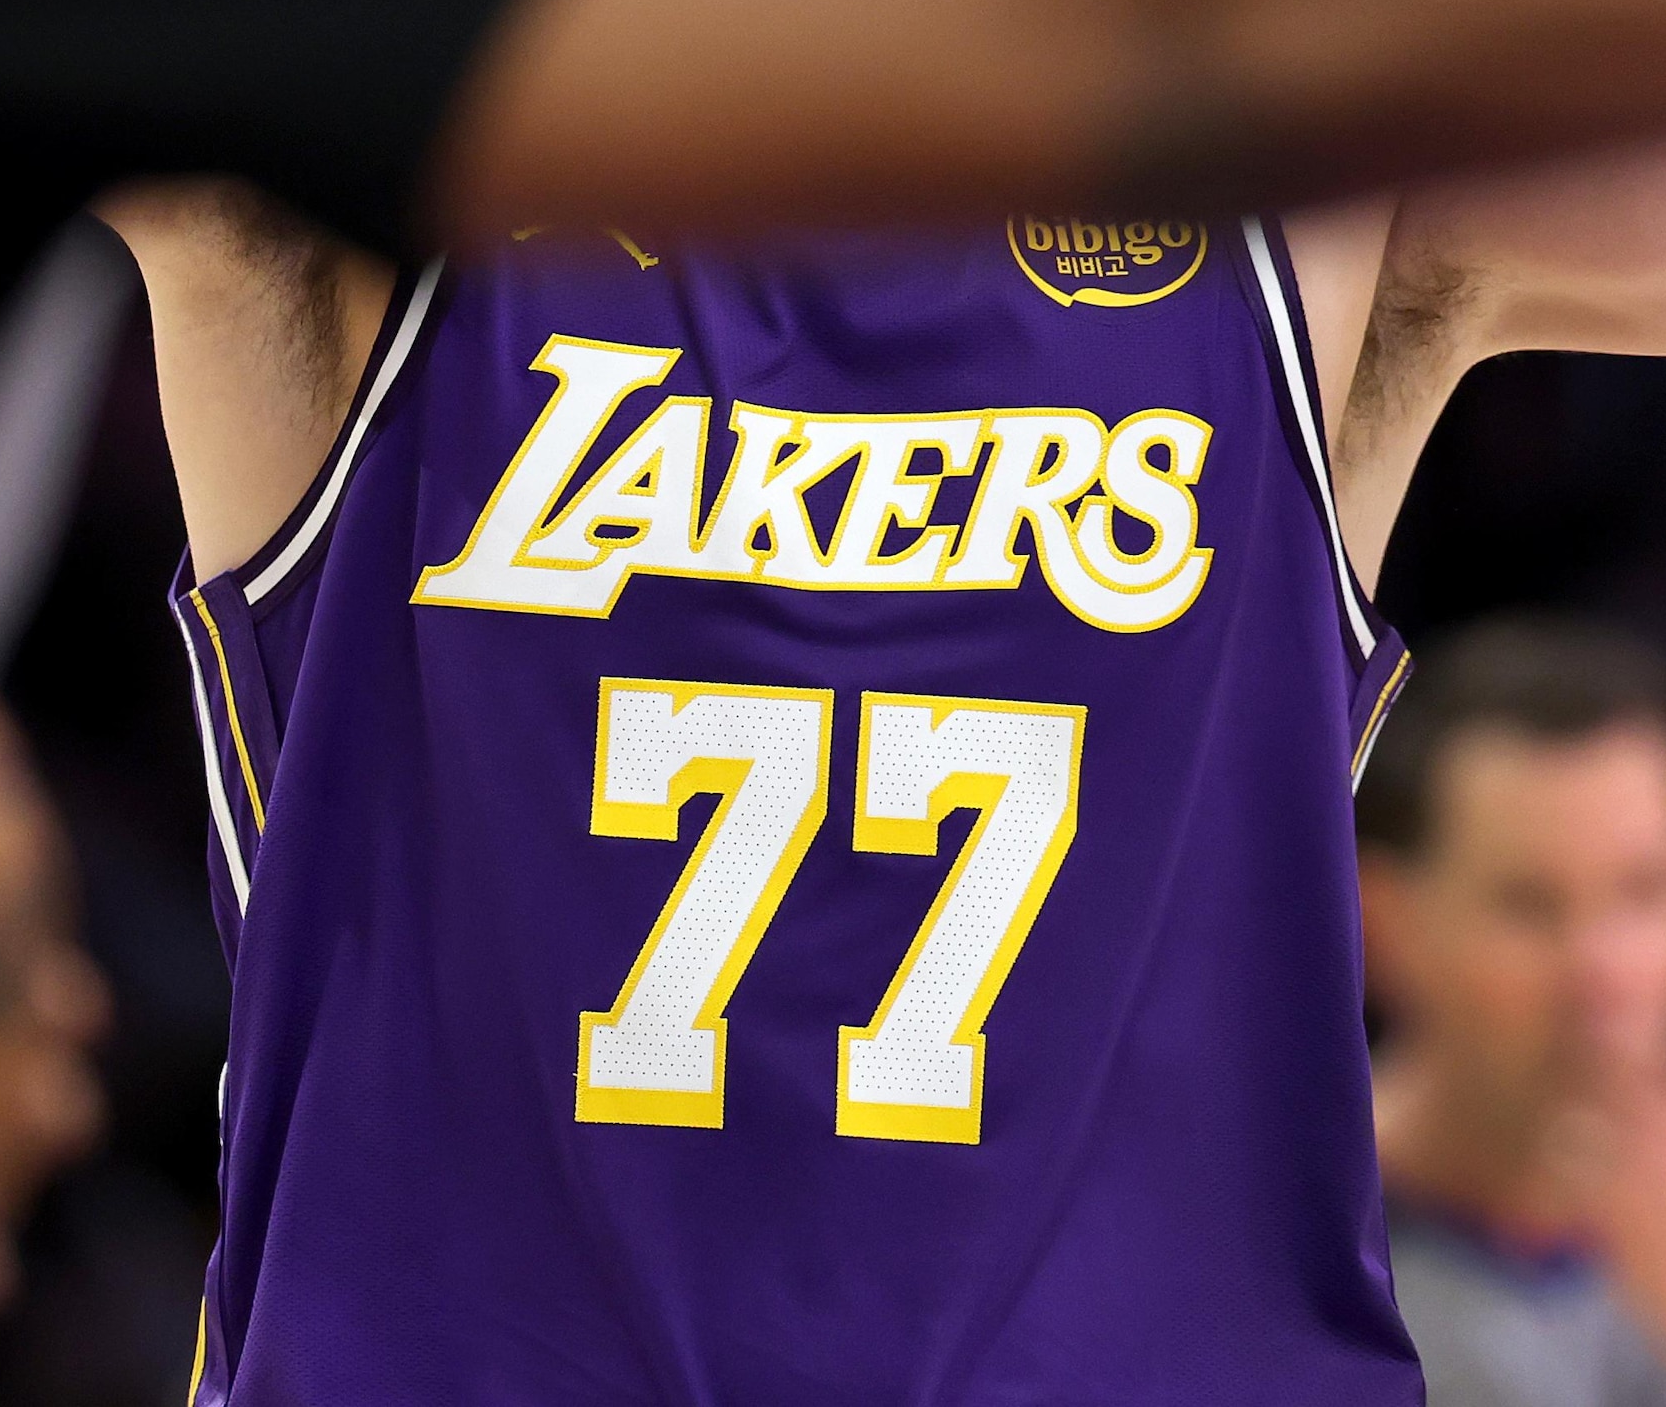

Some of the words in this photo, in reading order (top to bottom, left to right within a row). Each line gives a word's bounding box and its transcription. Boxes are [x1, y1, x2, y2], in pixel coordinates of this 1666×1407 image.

[1024, 211, 1194, 266] bibigo
[1055, 255, 1129, 278] 비비고
[409, 333, 1215, 634] LAKERS
[574, 676, 1089, 1146] 77
